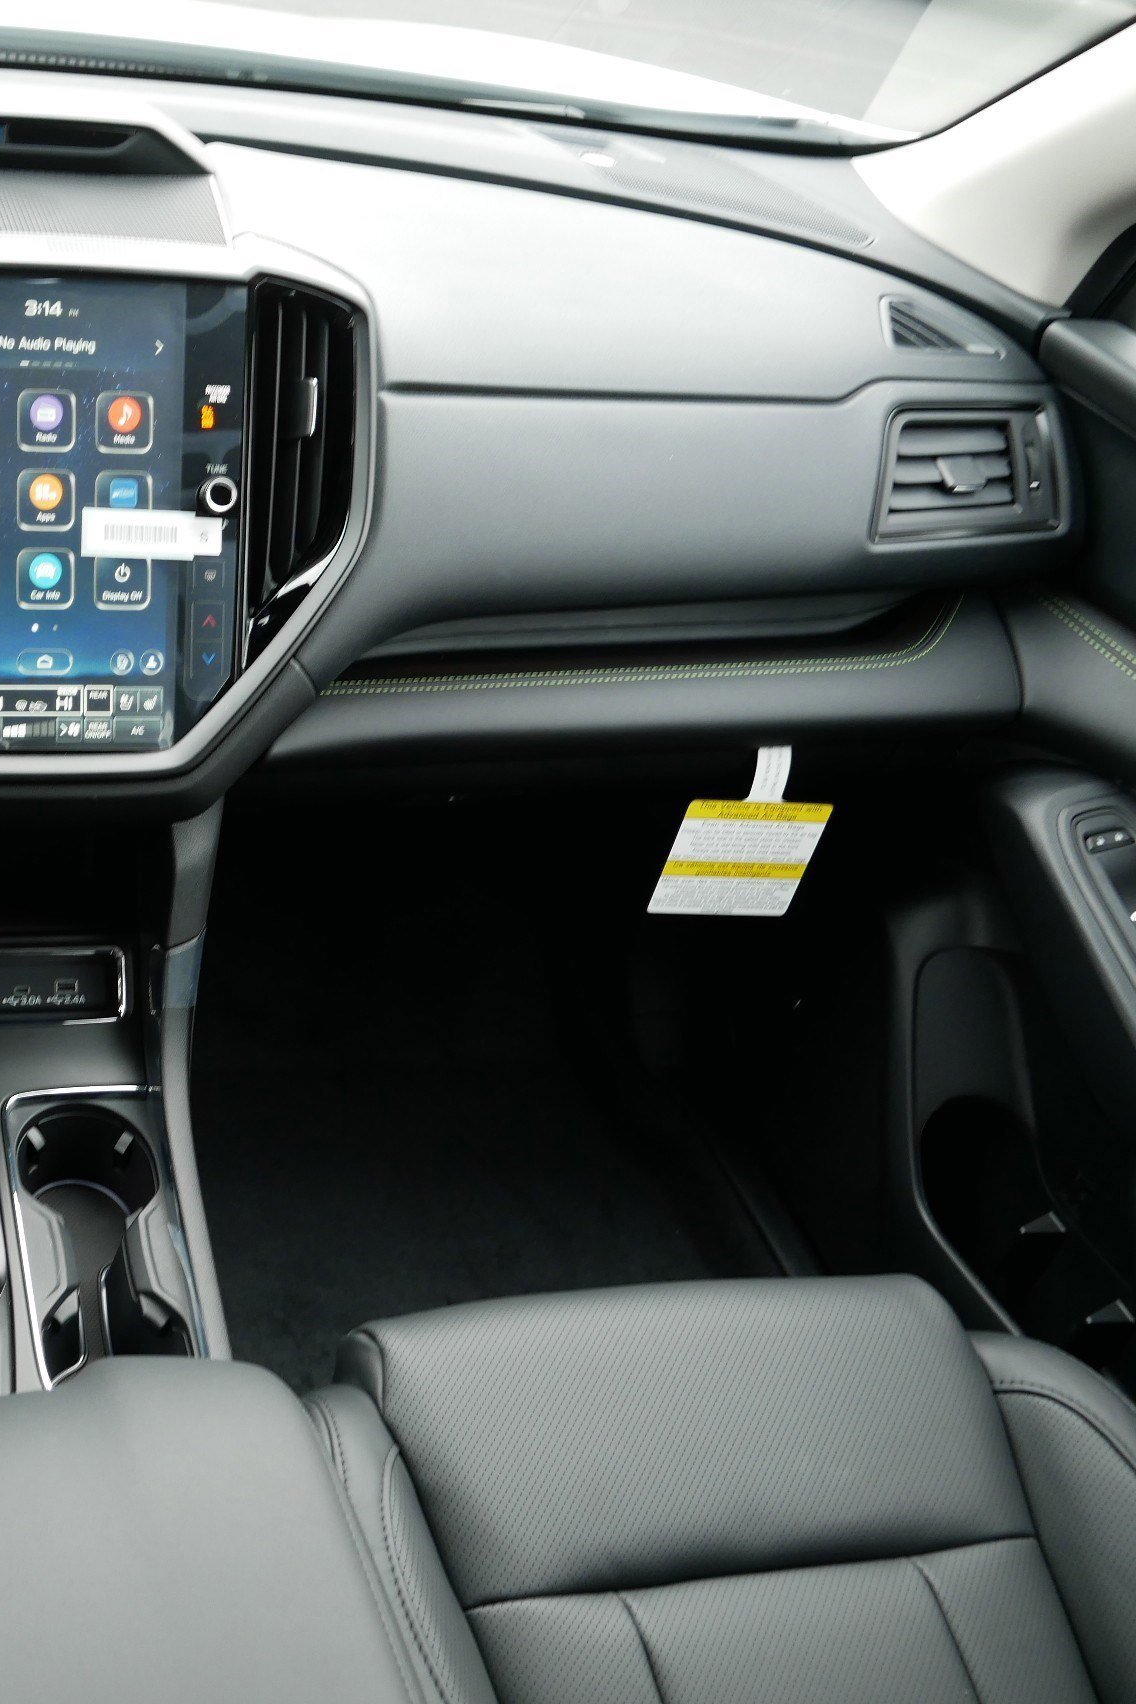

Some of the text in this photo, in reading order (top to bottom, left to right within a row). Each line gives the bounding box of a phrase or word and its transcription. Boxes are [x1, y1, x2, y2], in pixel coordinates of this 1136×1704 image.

[18, 335, 51, 351] Audio
[54, 336, 96, 355] Playing
[35, 431, 57, 443] Radio
[114, 432, 135, 444] Media
[36, 511, 57, 522] Apps
[30, 589, 61, 601] Car Info
[102, 589, 143, 603] Display Off
